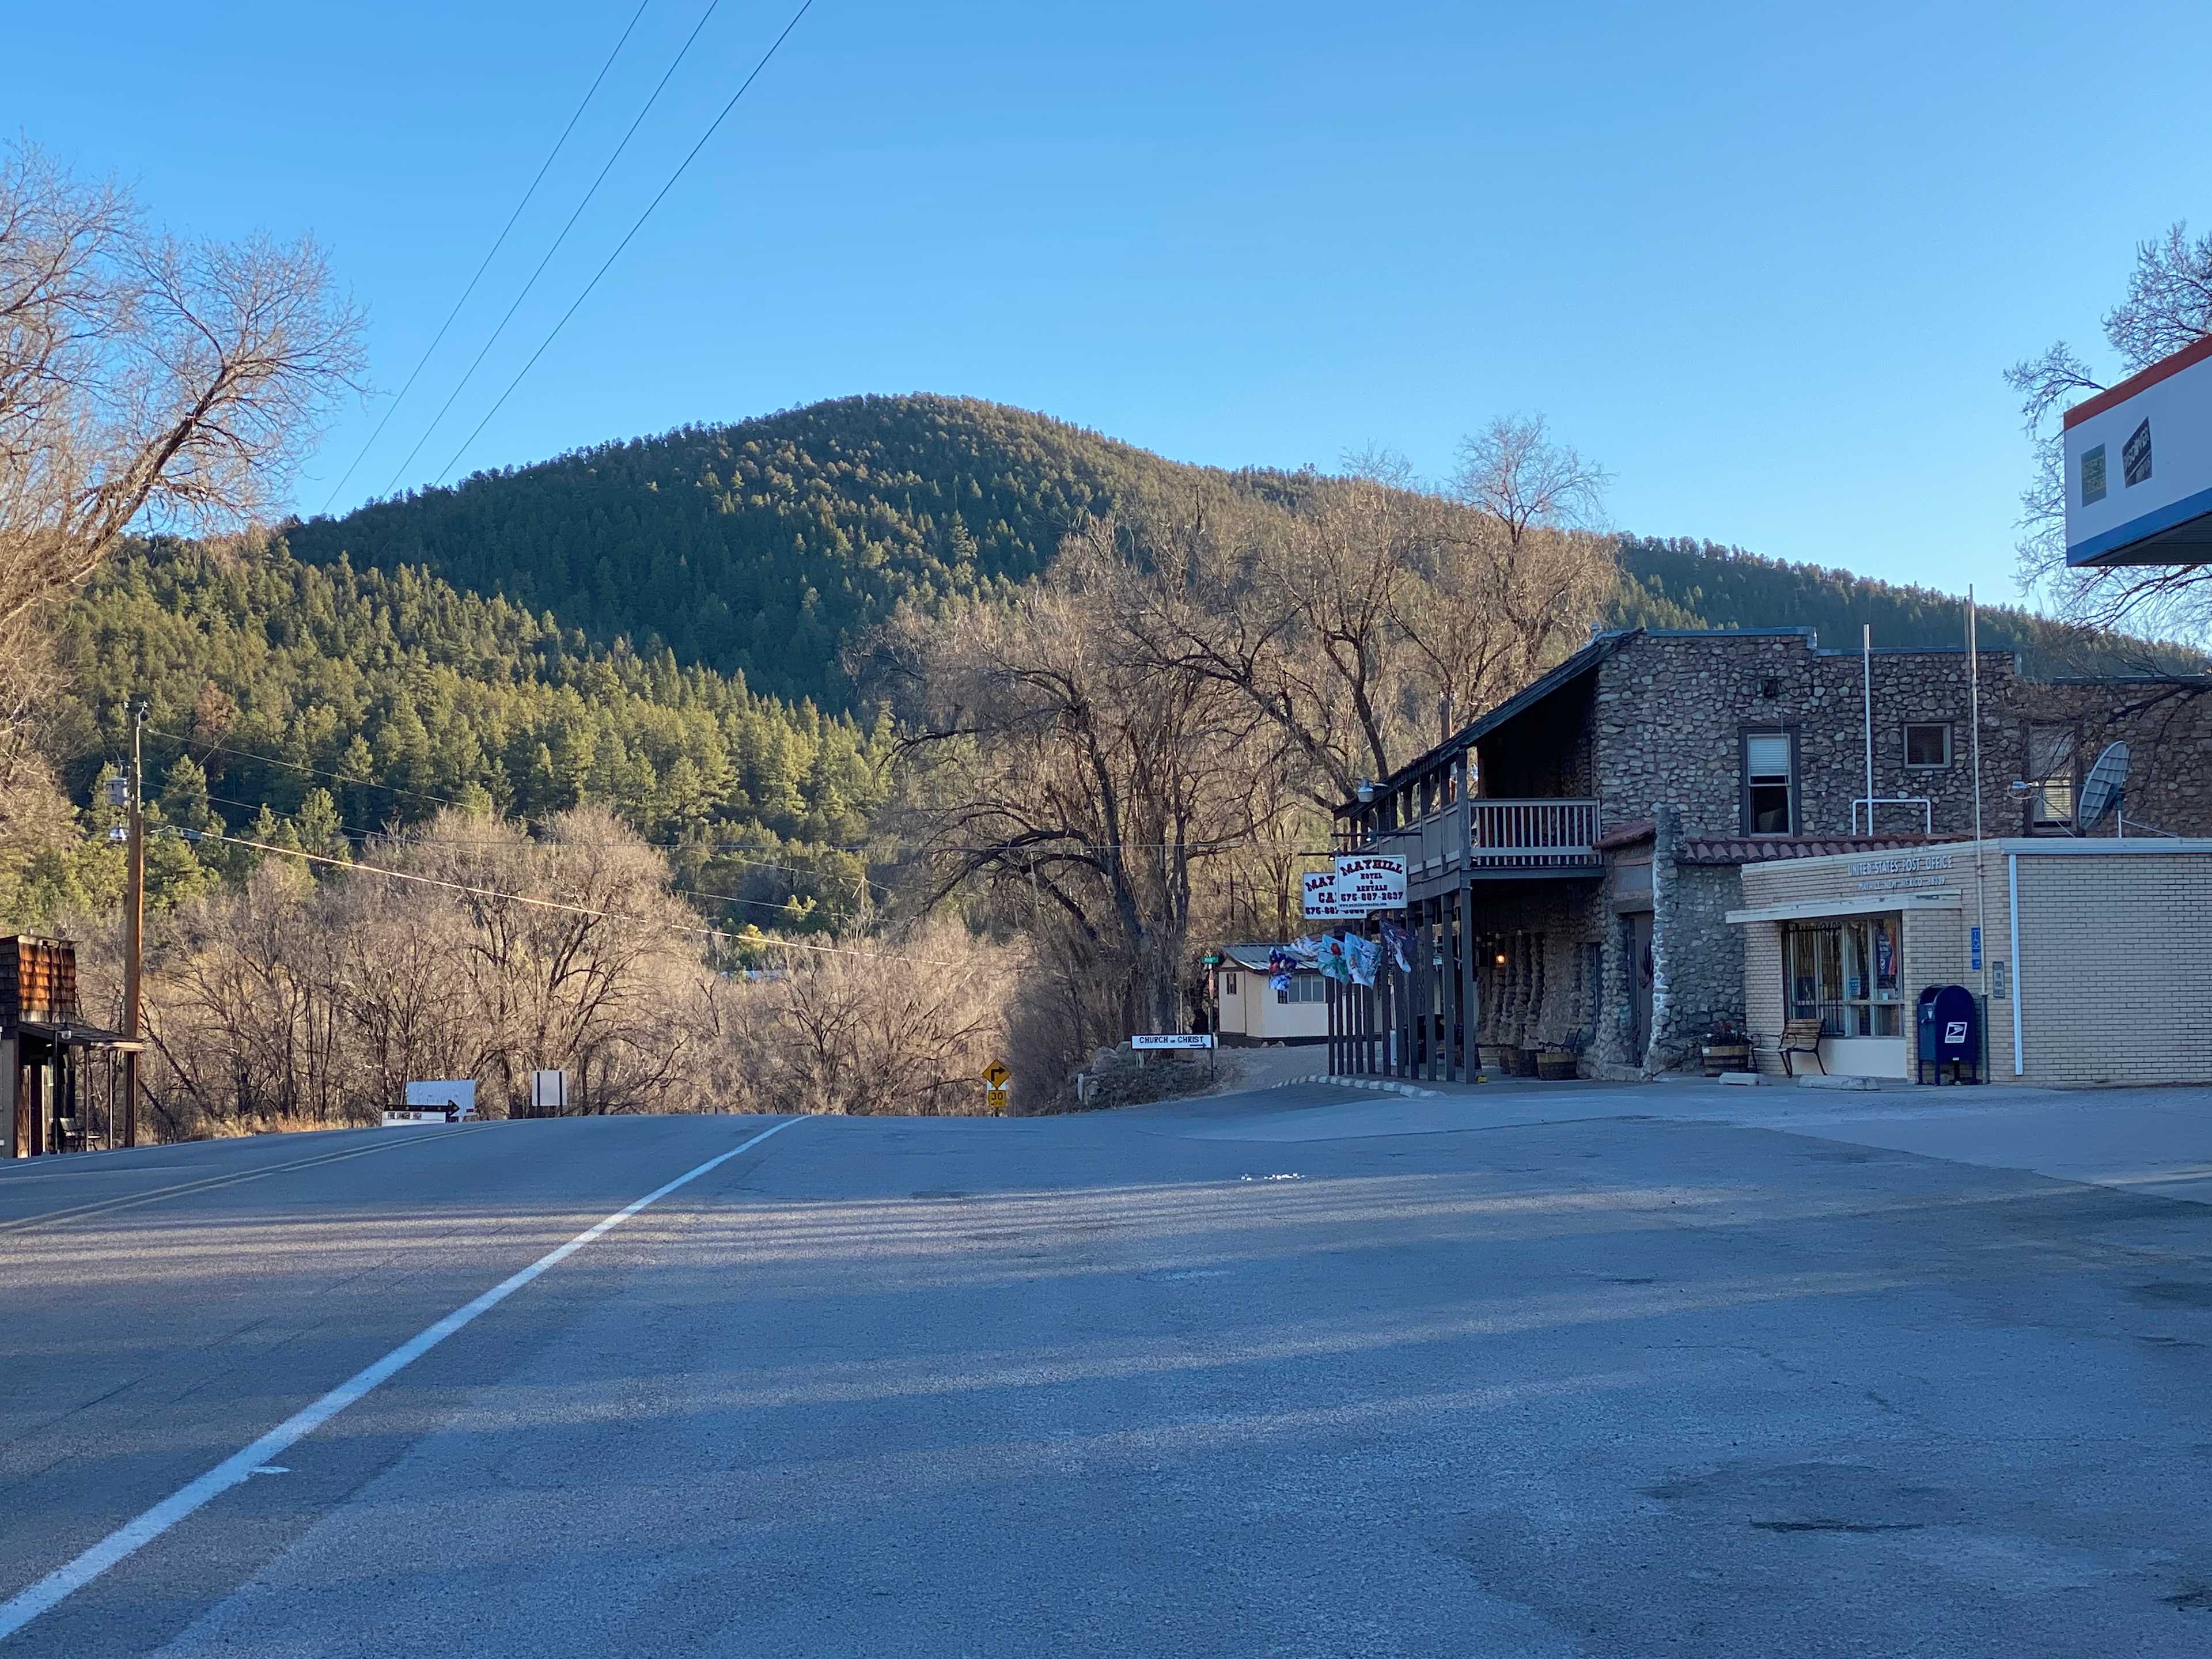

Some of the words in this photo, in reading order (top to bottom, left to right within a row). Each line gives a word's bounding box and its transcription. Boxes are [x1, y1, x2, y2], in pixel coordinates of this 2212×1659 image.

[1340, 859, 1403, 876] MAYHILL
[1848, 862, 1872, 876] UNITED
[1875, 860, 1899, 874] STATES
[1902, 858, 1921, 872] POST
[1925, 855, 1953, 869] OFFICE
[1305, 876, 1335, 892] MAY
[1319, 892, 1336, 903] CA
[991, 1092, 1003, 1100] 30
